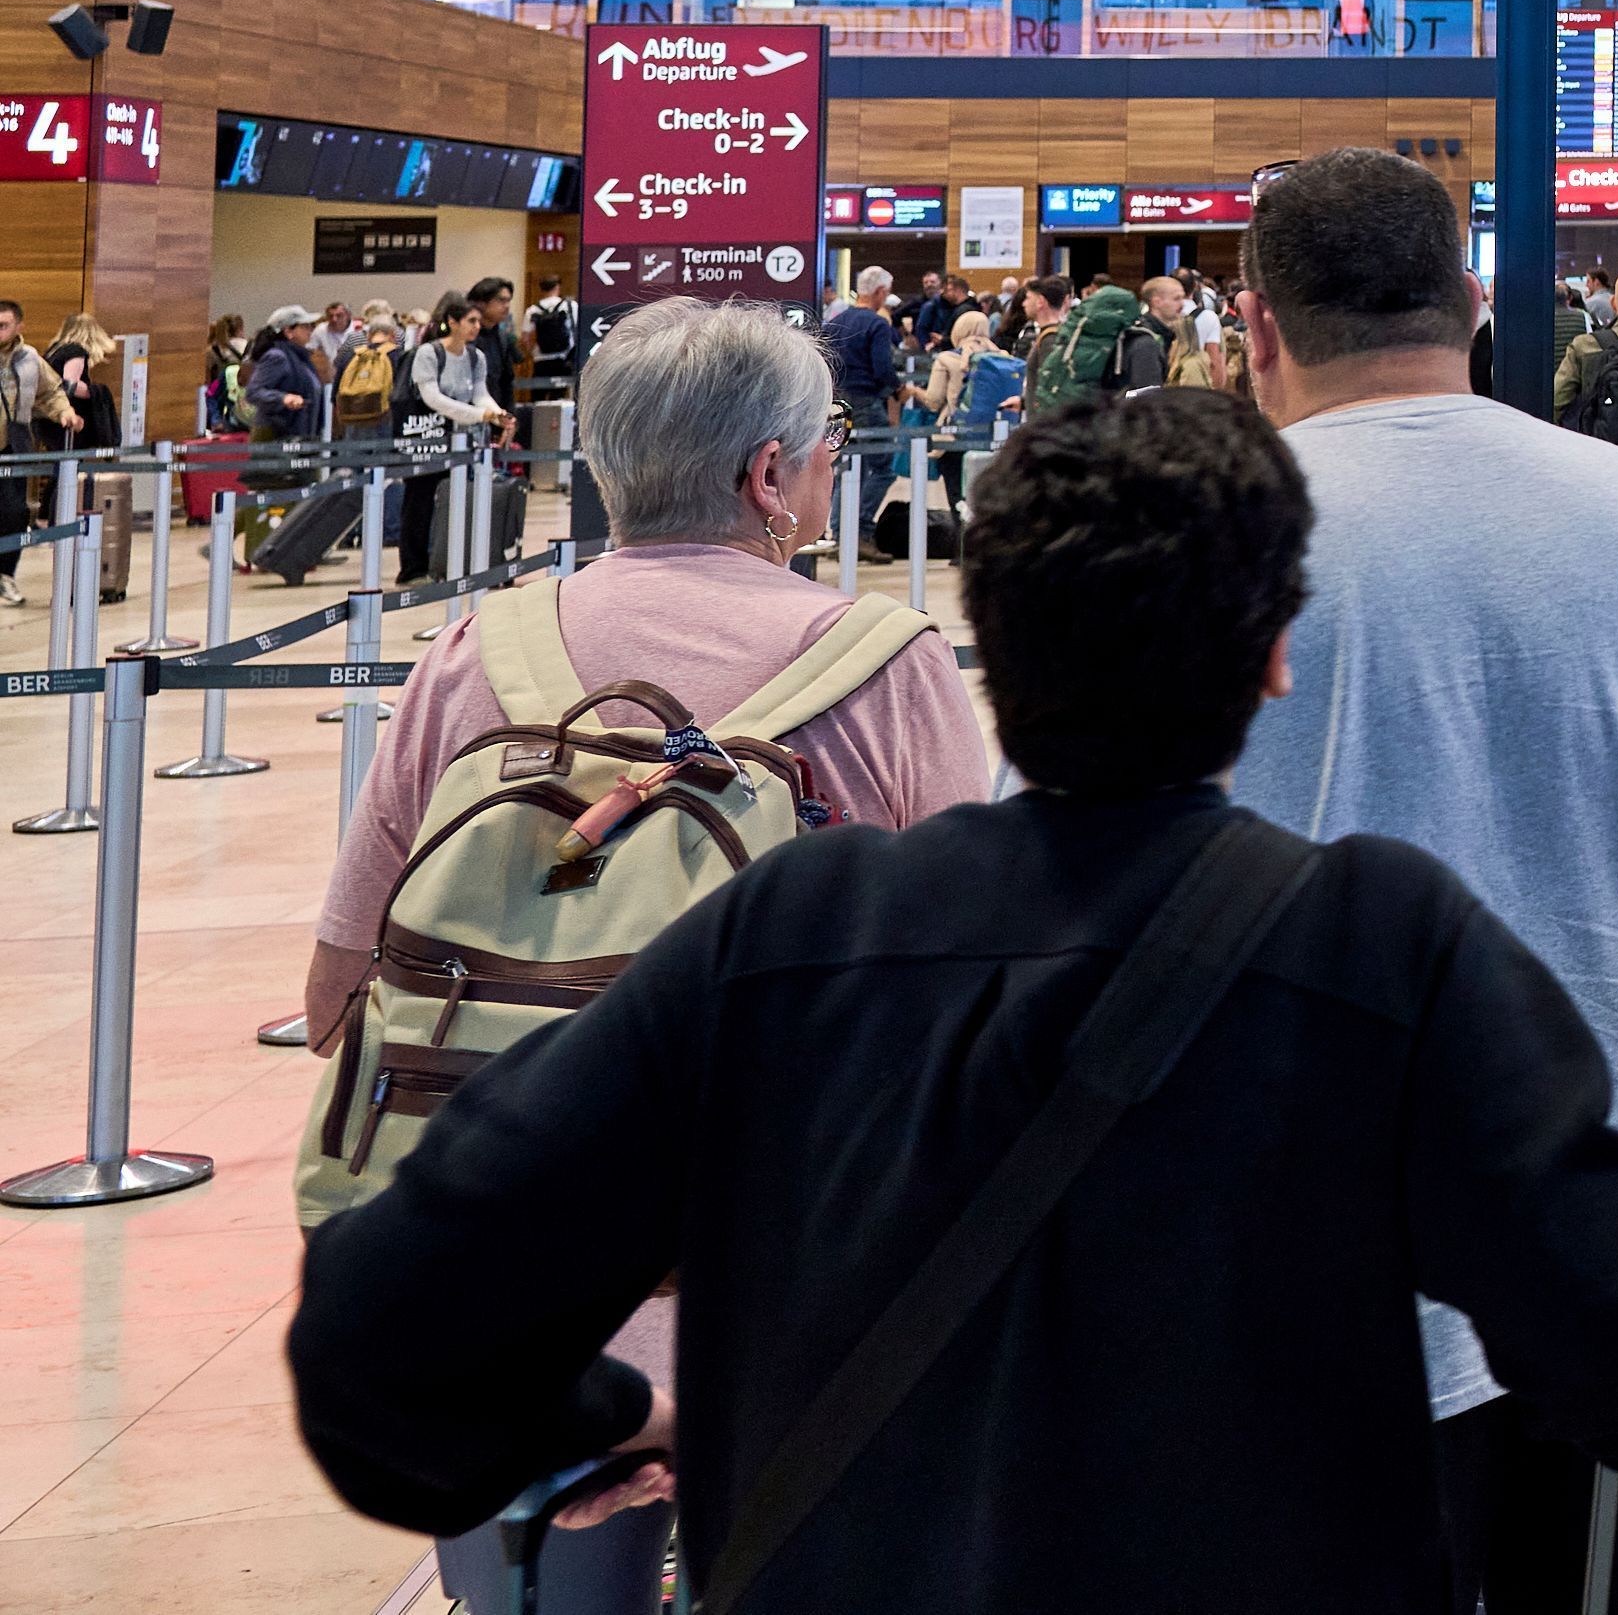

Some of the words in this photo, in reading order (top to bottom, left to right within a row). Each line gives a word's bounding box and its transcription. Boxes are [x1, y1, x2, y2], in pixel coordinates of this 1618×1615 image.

[642, 37, 726, 65] Abflug
[643, 63, 737, 84] Departure
[658, 108, 765, 130] Check-in
[27, 102, 78, 164] 4
[141, 108, 159, 168] 4
[640, 173, 746, 195] Check-in
[1072, 188, 1117, 203] Priority
[681, 246, 763, 264] Terminal
[772, 255, 797, 272] T2
[697, 267, 725, 281] 500
[728, 269, 742, 280] m
[6, 674, 50, 695] BER
[329, 665, 371, 686] BER
[663, 739, 705, 756] BAGGA
[665, 730, 711, 746] ROVED
